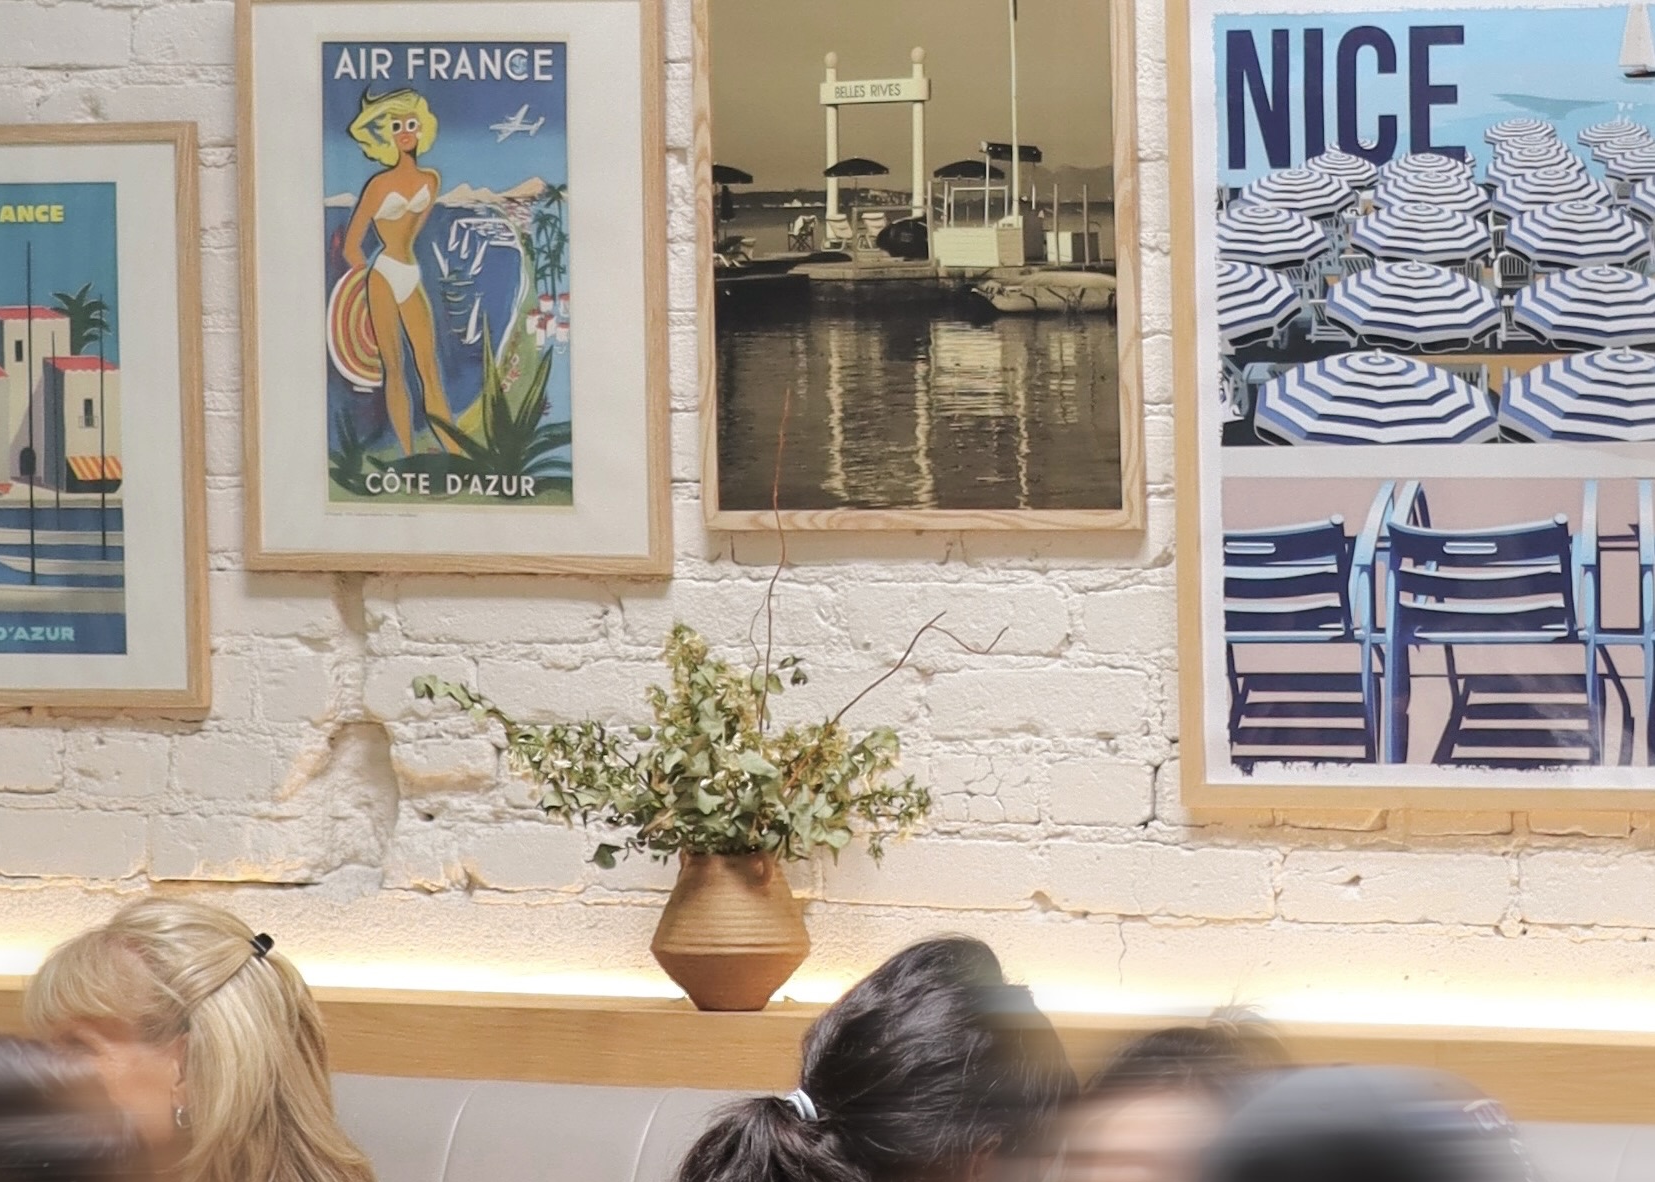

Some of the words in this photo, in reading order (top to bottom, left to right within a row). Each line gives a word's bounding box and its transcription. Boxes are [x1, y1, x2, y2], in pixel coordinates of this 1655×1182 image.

[334, 47, 393, 80] AIR
[407, 47, 554, 81] FRANCE
[834, 85, 866, 99] BELLES
[870, 83, 902, 97] RIVES
[1226, 25, 1466, 169] NICE
[365, 467, 431, 495] CÔTE
[446, 473, 536, 497] D'AZUR
